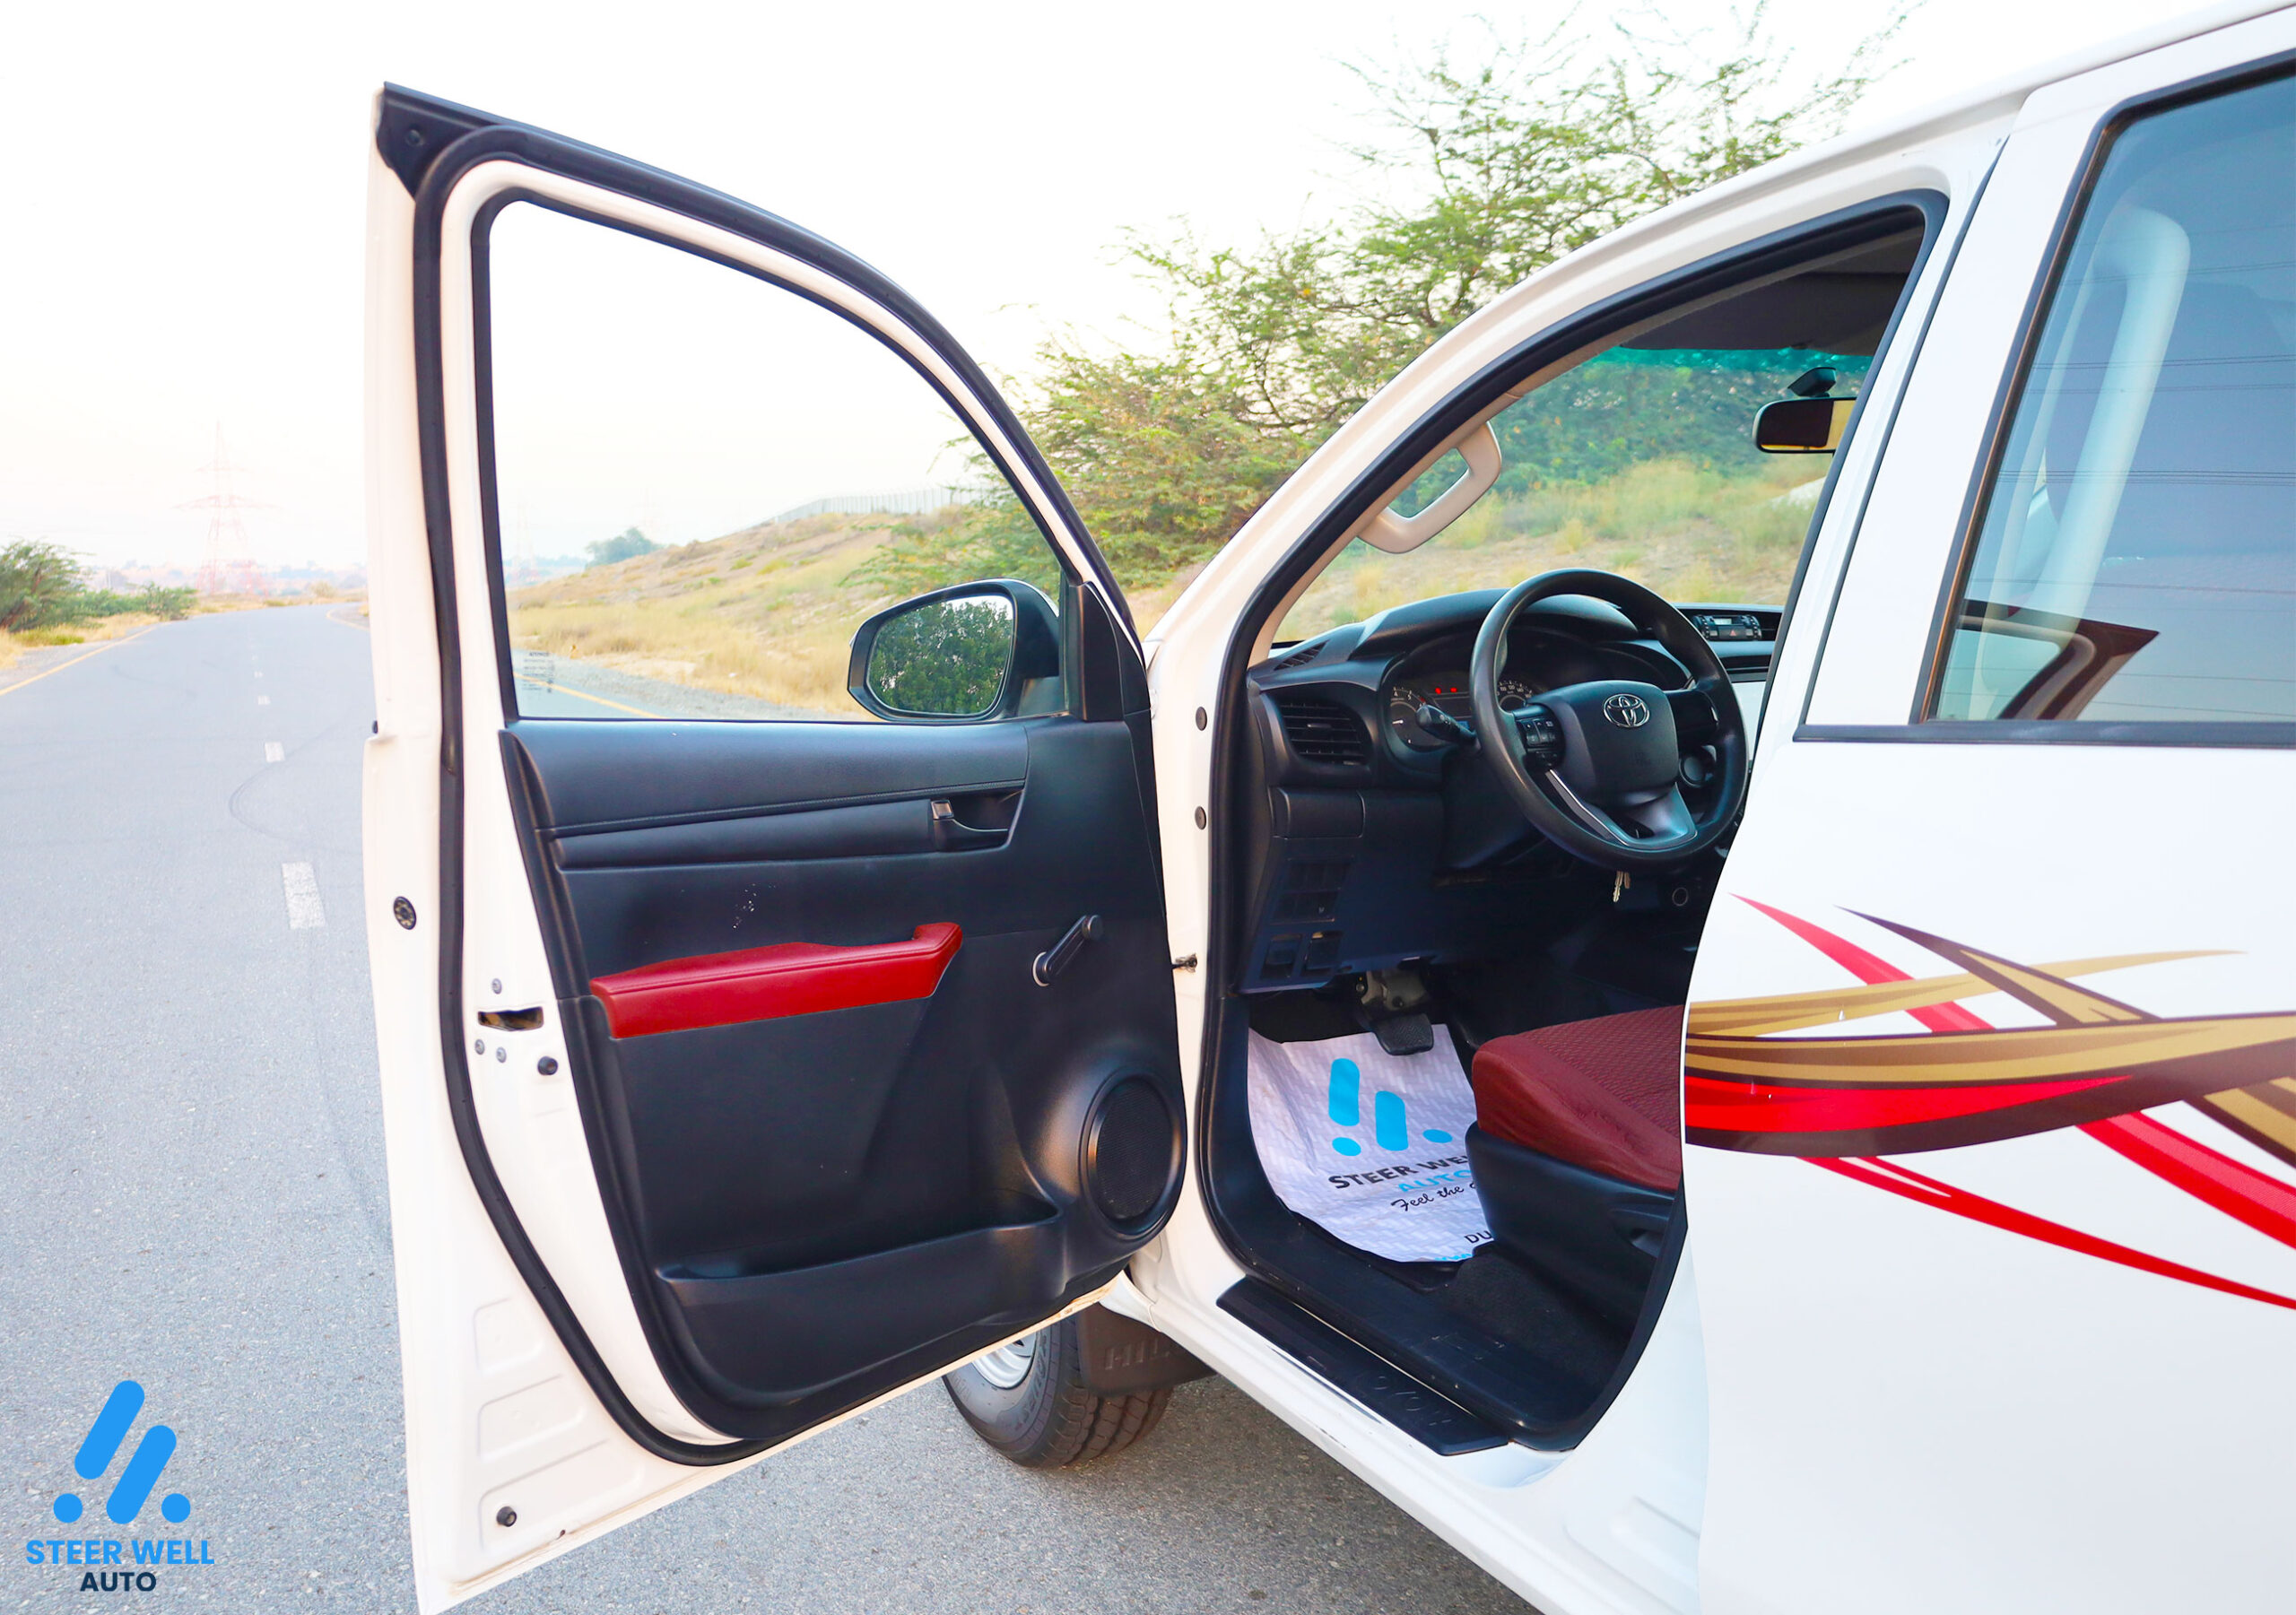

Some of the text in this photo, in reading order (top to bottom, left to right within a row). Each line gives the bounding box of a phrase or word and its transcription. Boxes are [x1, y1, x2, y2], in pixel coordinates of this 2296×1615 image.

[1328, 1165, 1418, 1189] STEER
[1390, 1193, 1434, 1211] Feel
[1437, 1185, 1465, 1198] the
